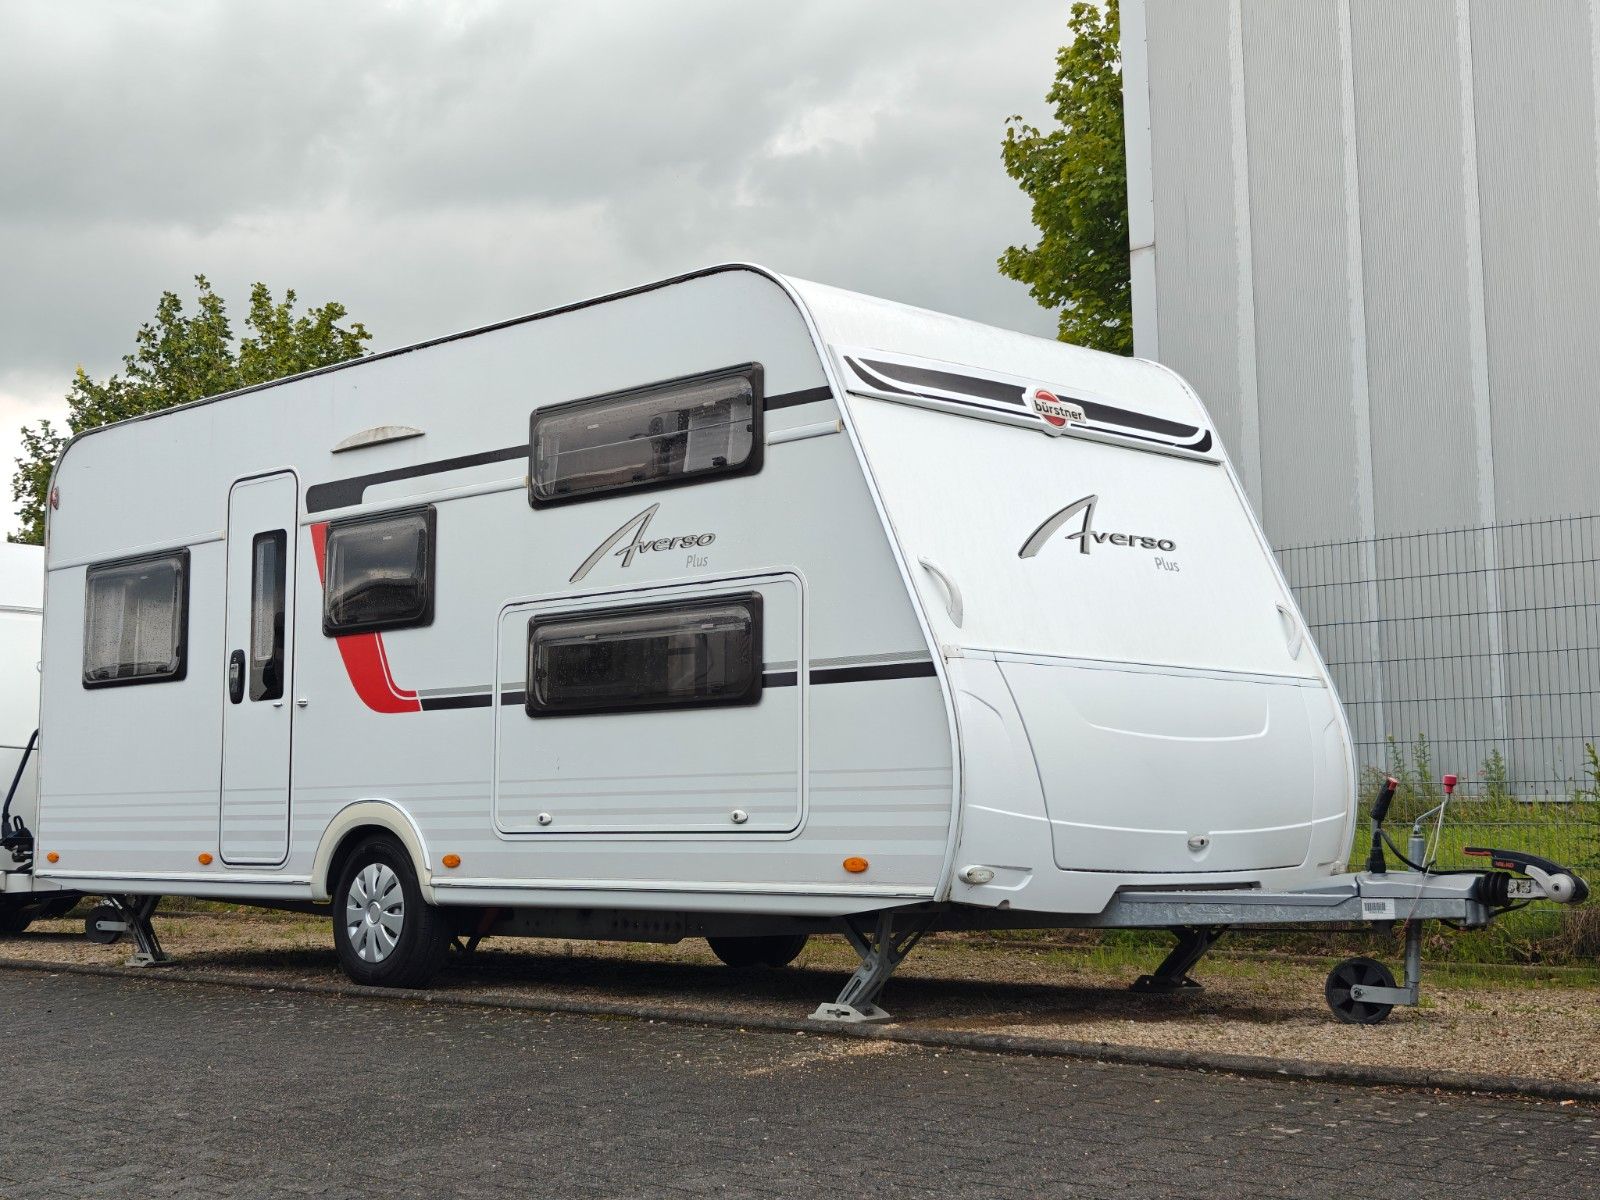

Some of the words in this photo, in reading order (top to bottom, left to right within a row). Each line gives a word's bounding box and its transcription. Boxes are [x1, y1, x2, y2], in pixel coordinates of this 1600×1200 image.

[1034, 399, 1082, 420] bürstner
[1018, 494, 1177, 559] Averso
[569, 502, 716, 584] Averso
[685, 555, 708, 568] Plus
[1155, 557, 1180, 572] Plus
